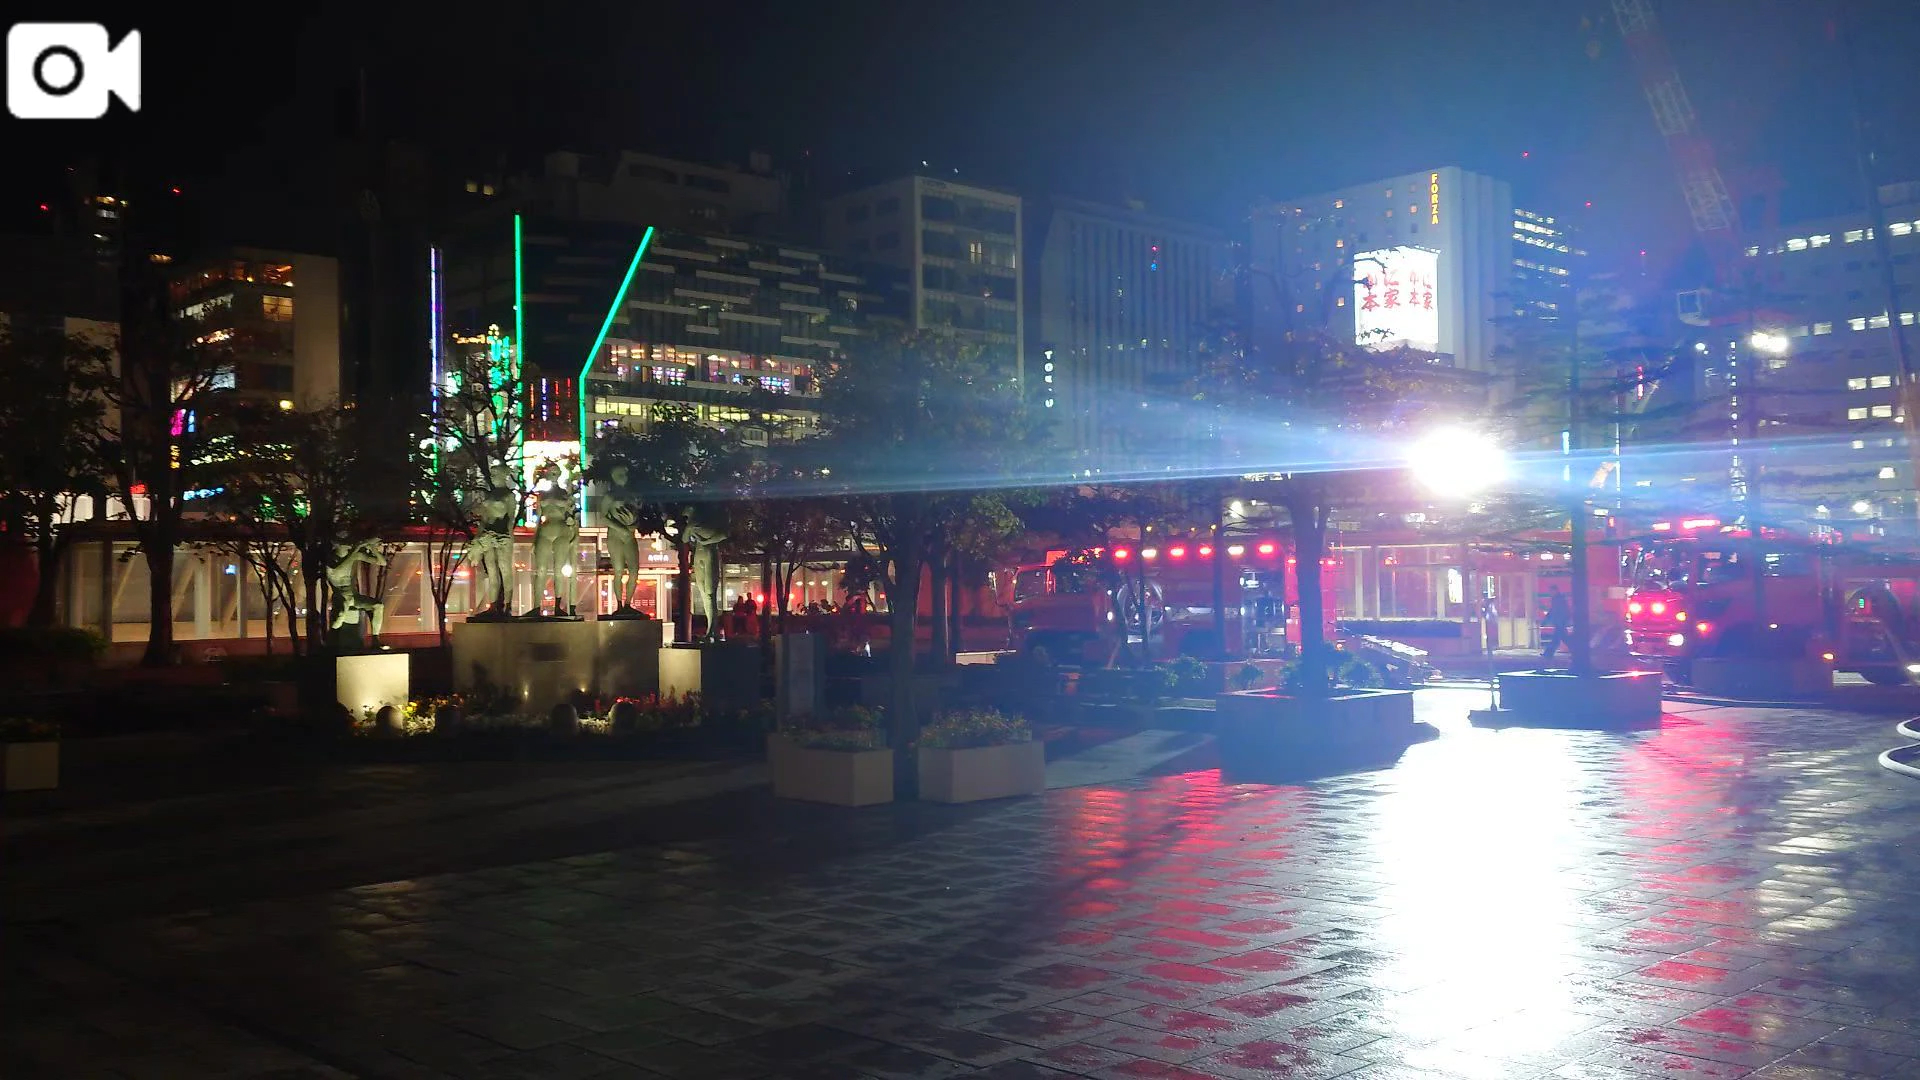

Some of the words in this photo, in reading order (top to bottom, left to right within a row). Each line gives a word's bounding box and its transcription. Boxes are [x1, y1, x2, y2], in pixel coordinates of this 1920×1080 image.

[1431, 173, 1439, 225] FORZA
[1361, 287, 1401, 312] 本家
[1409, 287, 1433, 310] 本家
